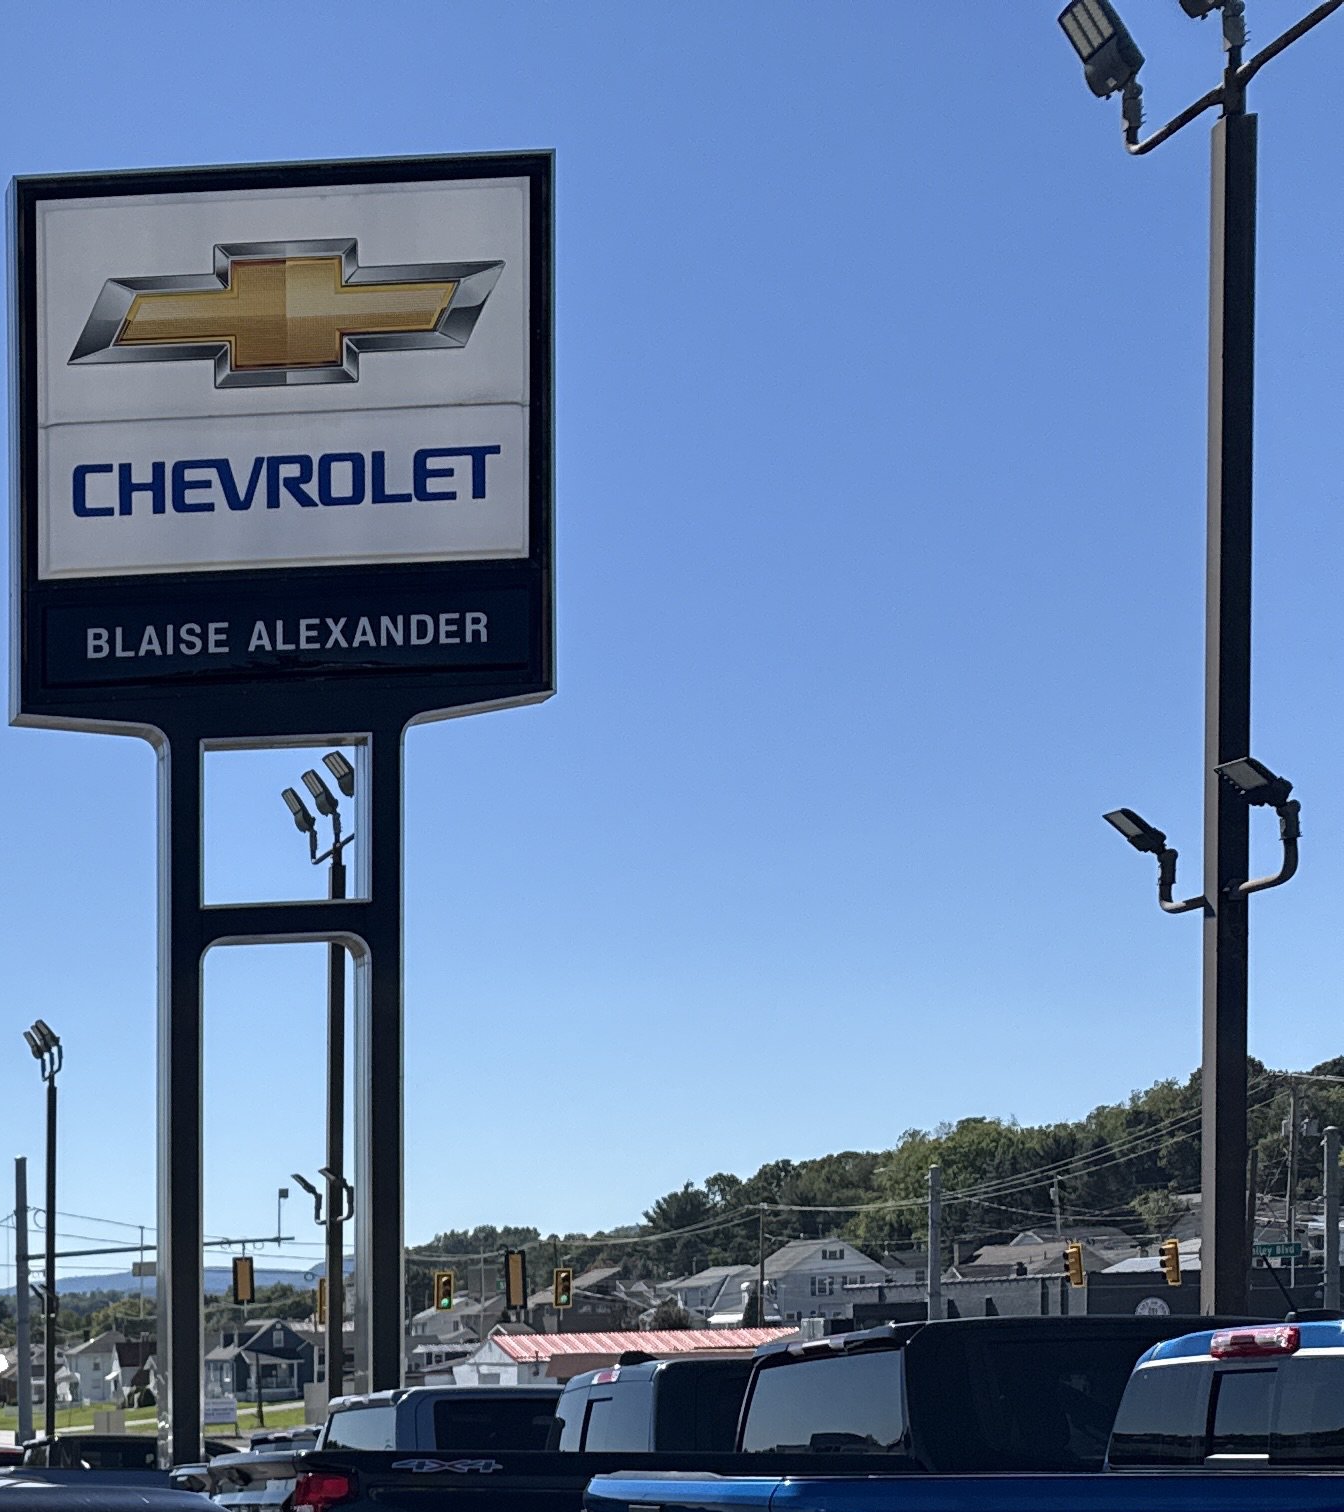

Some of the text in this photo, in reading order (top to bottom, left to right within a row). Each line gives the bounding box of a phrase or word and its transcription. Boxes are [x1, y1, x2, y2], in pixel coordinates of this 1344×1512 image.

[71, 445, 502, 518] CHEVROLET
[86, 611, 489, 659] BLAISE ALEXANDER
[1252, 1244, 1295, 1257] alley Blvd
